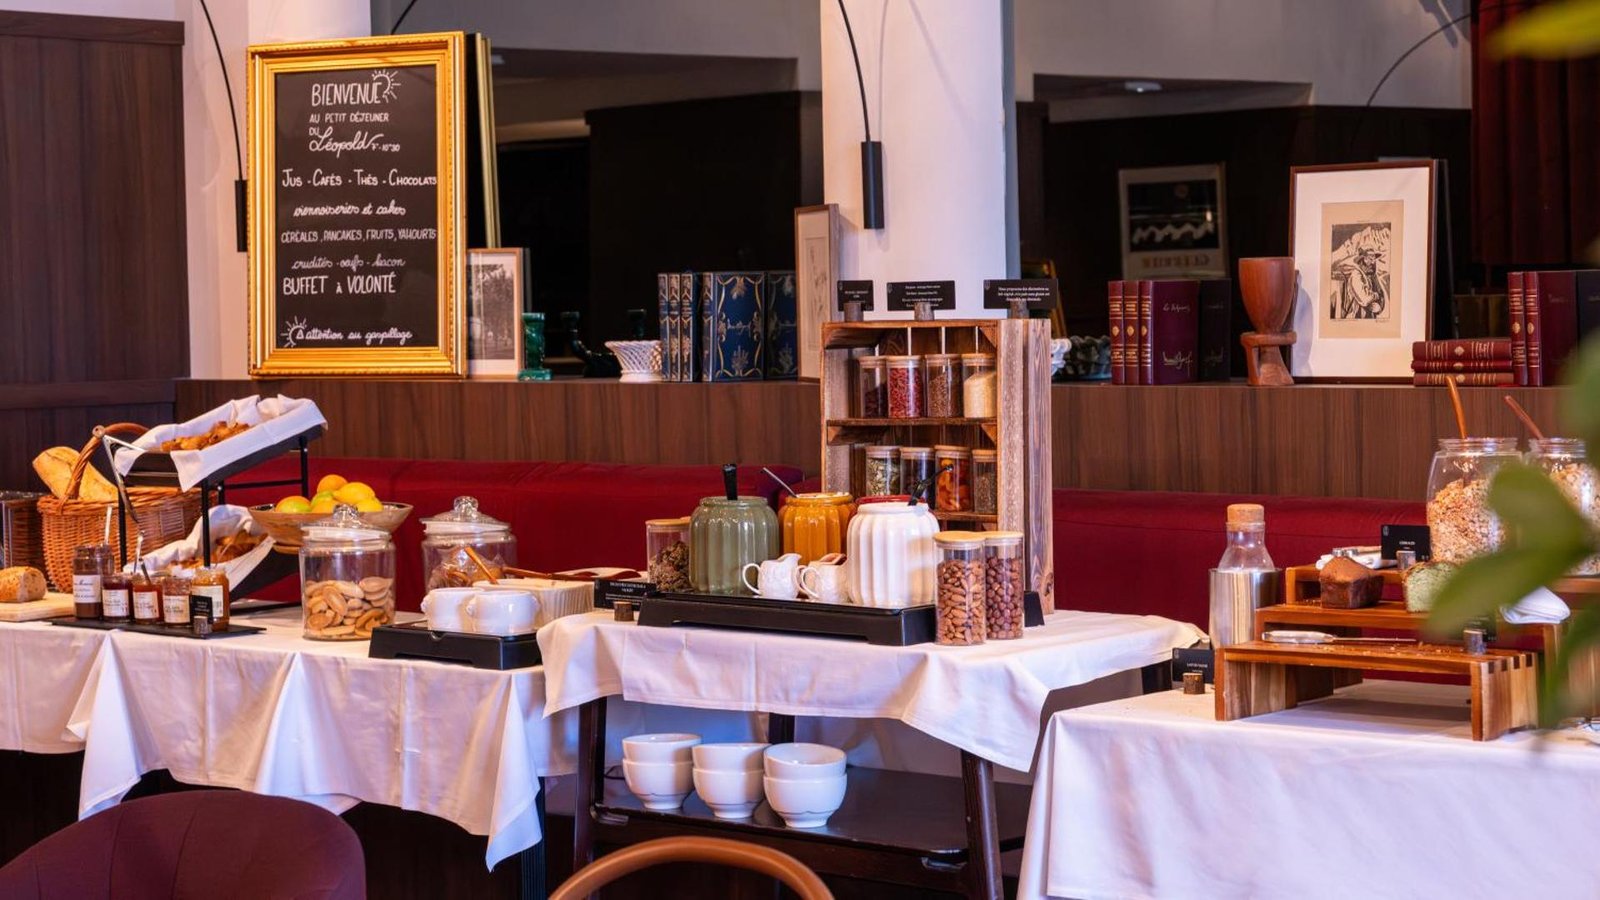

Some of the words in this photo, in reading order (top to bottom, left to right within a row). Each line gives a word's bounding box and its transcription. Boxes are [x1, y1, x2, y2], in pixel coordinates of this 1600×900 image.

[311, 82, 382, 107] BIENVENUE
[309, 113, 320, 124] AU
[325, 113, 346, 123] PETIT
[350, 111, 389, 122] DÉJEUNER
[309, 127, 319, 136] DU
[309, 126, 384, 159] Léopold
[293, 202, 360, 217] viennoiseries
[361, 203, 373, 215] et
[376, 199, 406, 216] cakes
[291, 256, 333, 270] crudités
[372, 253, 406, 267] bacon
[283, 275, 328, 295] BUFFET
[347, 271, 396, 294] VOLONTÉ
[306, 328, 343, 340] attention
[365, 327, 413, 345] gaspillage
